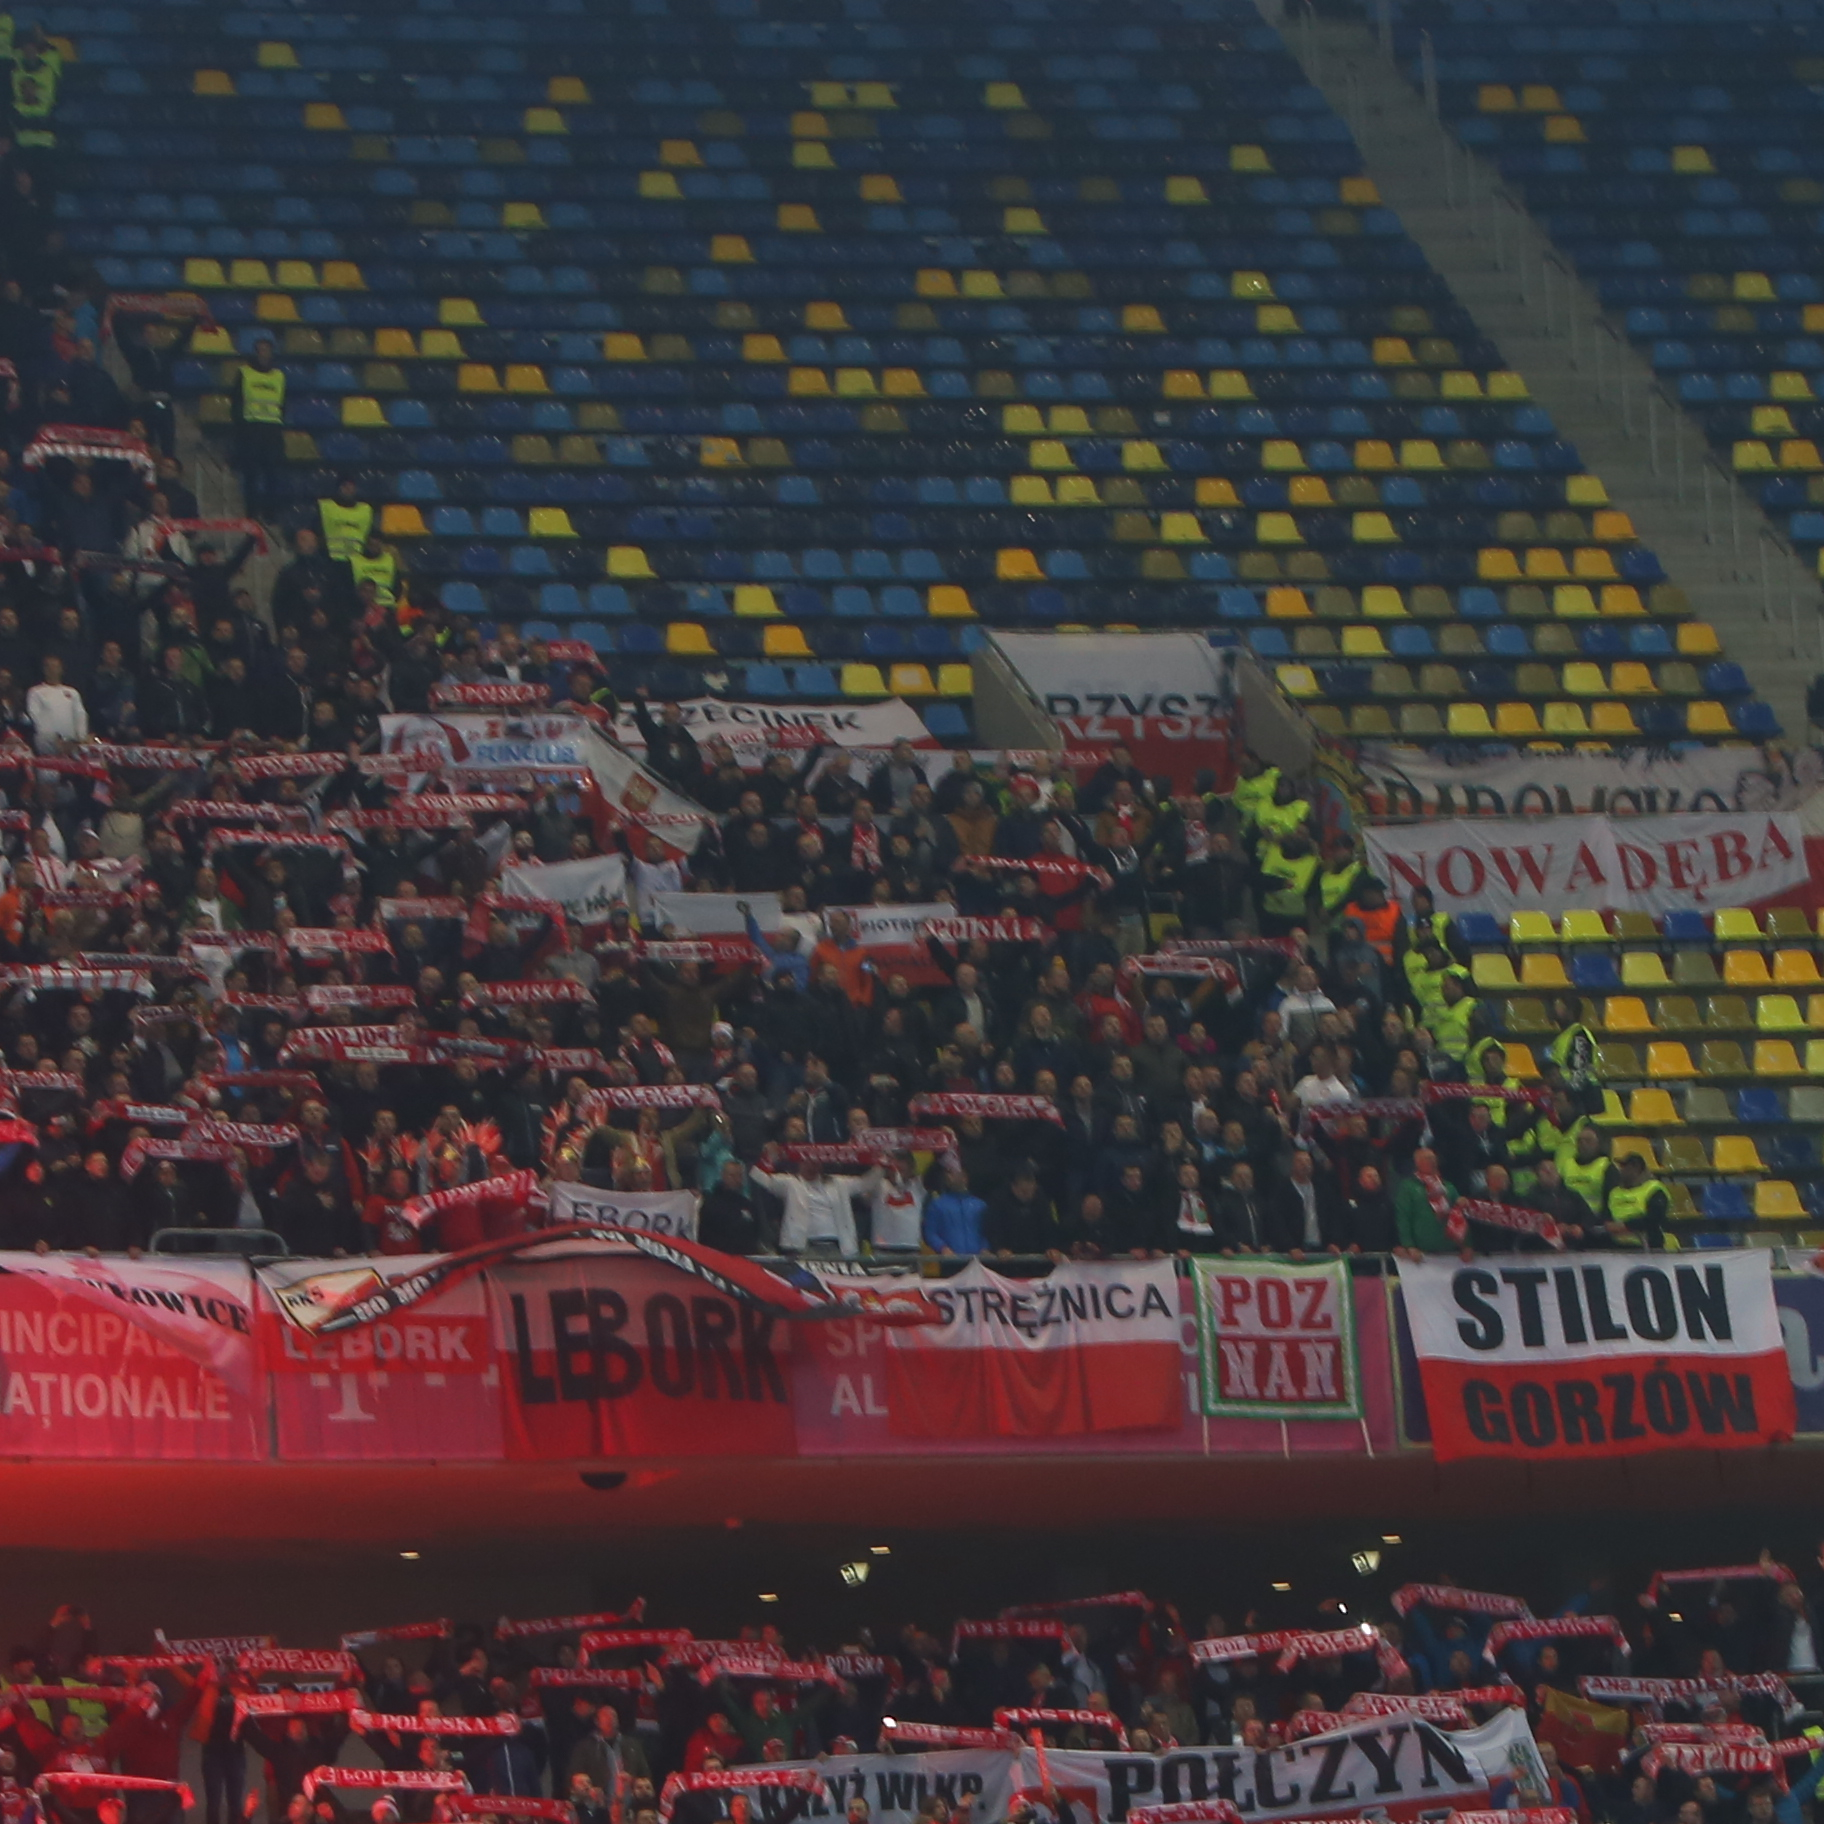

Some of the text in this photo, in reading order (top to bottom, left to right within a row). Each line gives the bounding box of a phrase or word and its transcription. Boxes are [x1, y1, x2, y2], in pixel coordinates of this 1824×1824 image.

[1385, 818, 1795, 899] NOWA DĘBA
[1217, 1275, 1333, 1331] POZ
[1452, 1262, 1733, 1351] STILON
[1462, 1359, 1760, 1448] GORZÓW
[691, 1770, 780, 1786] POLSKA
[759, 1764, 867, 1820] KRZYŻ
[1105, 1713, 1478, 1822] POŁCZYN
